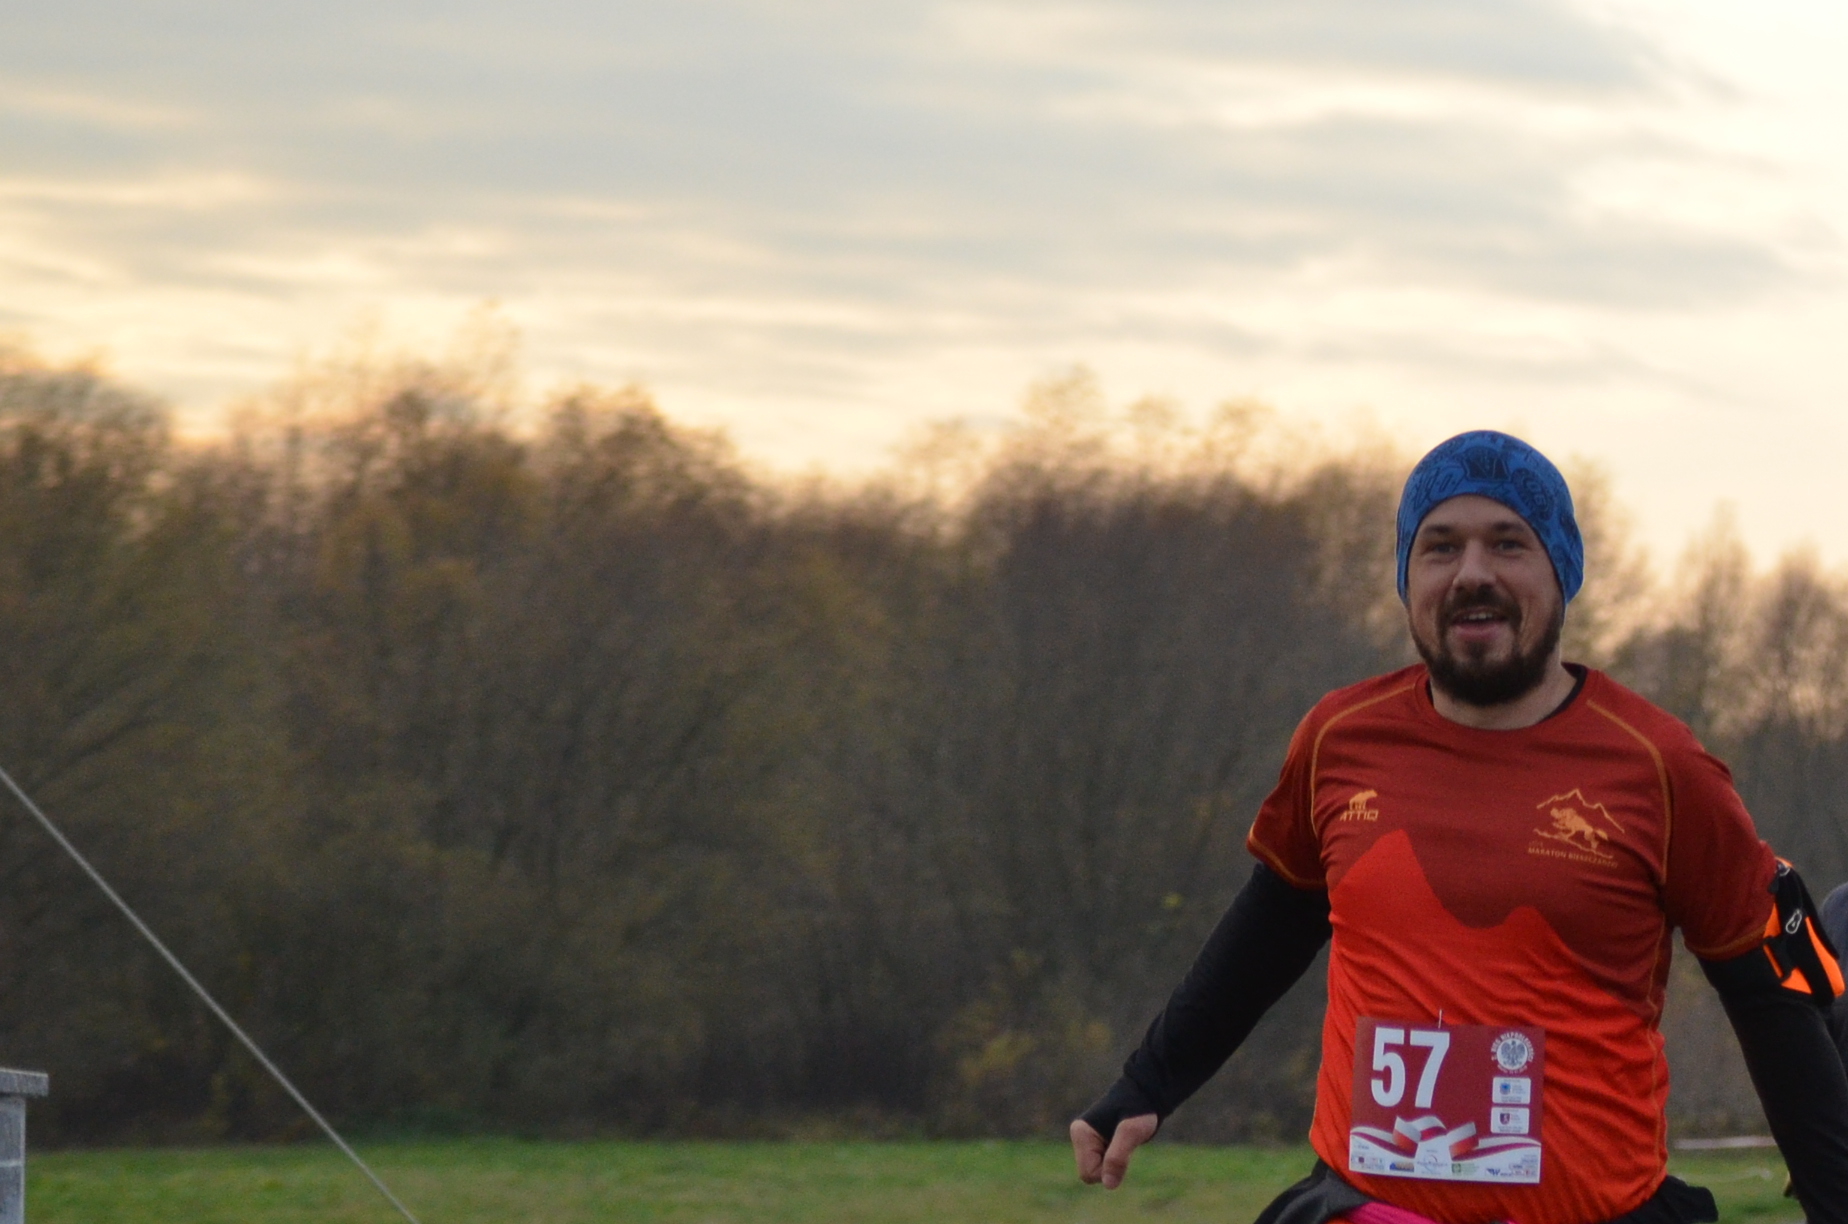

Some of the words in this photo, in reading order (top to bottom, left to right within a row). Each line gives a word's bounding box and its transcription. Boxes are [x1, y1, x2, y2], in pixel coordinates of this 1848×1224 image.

[1340, 810, 1379, 821] ATTIQ
[1528, 847, 1567, 858] MARATON
[1370, 1027, 1450, 1109] 57
